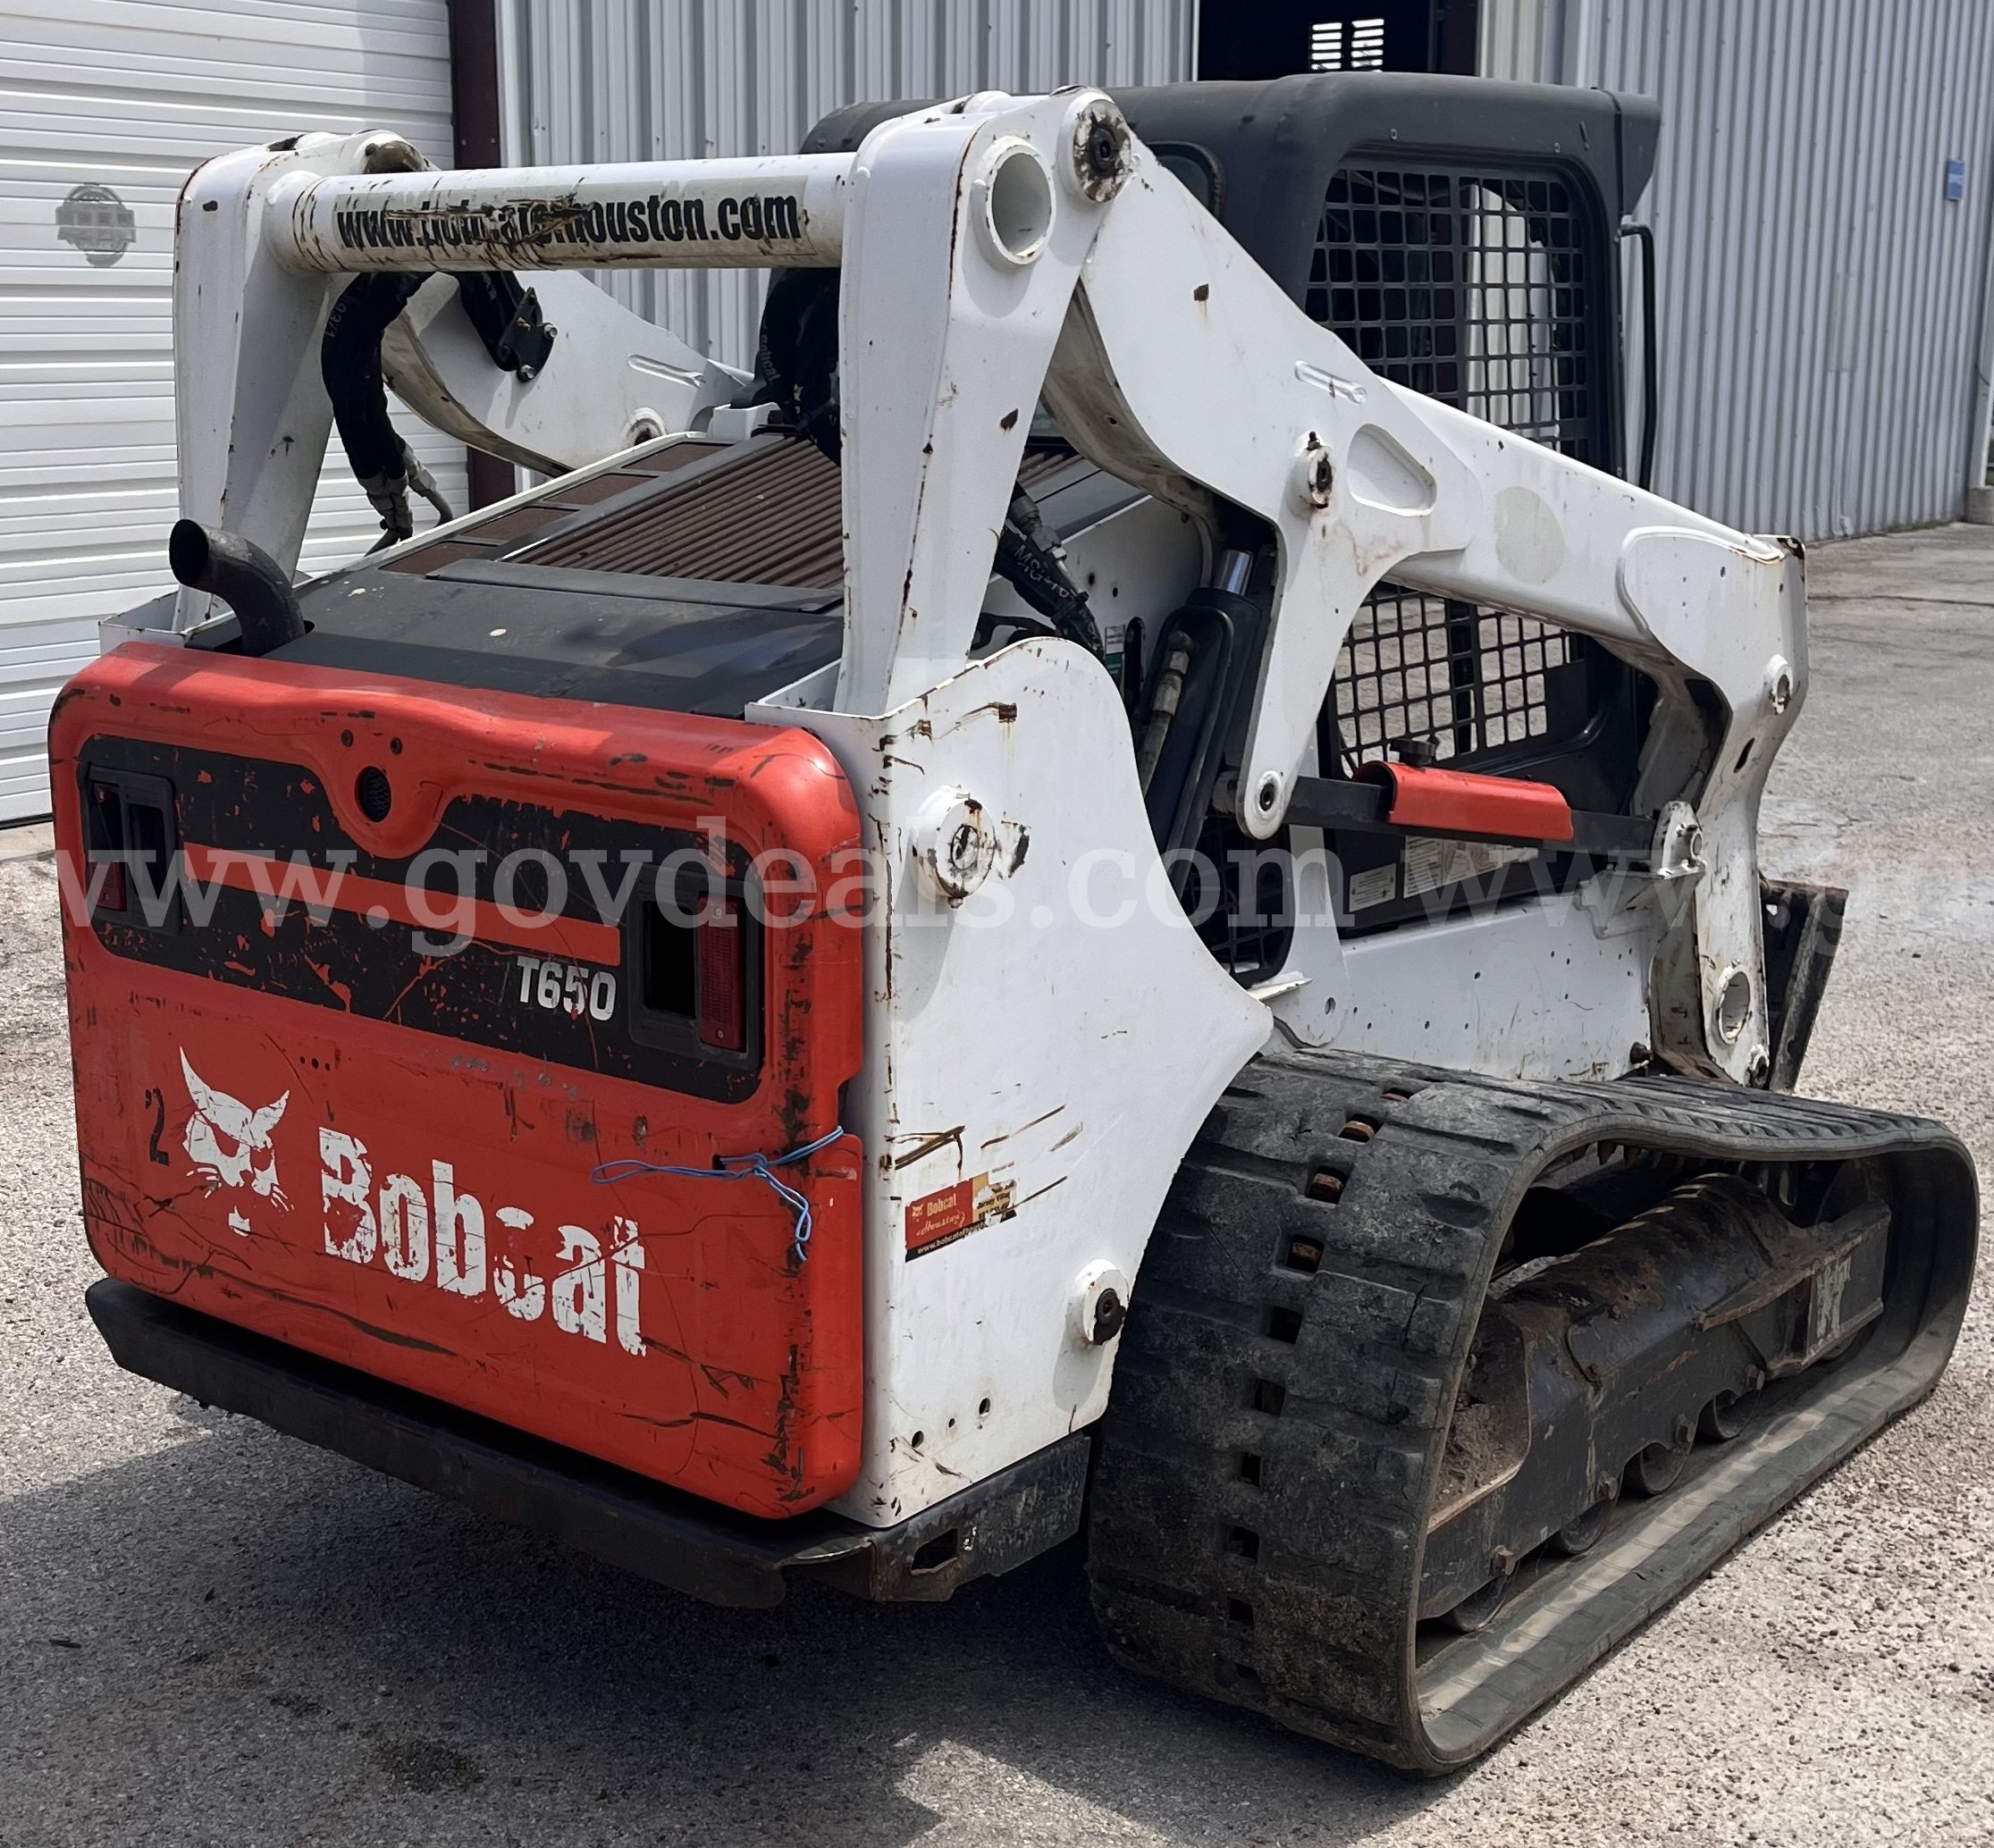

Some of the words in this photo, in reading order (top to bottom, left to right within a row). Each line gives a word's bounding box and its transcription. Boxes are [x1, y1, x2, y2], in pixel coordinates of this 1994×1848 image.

[517, 955, 617, 1021] T650
[145, 1087, 170, 1166] 2
[927, 1193, 957, 1217] Bobcat
[318, 1127, 648, 1357] Bobcat
